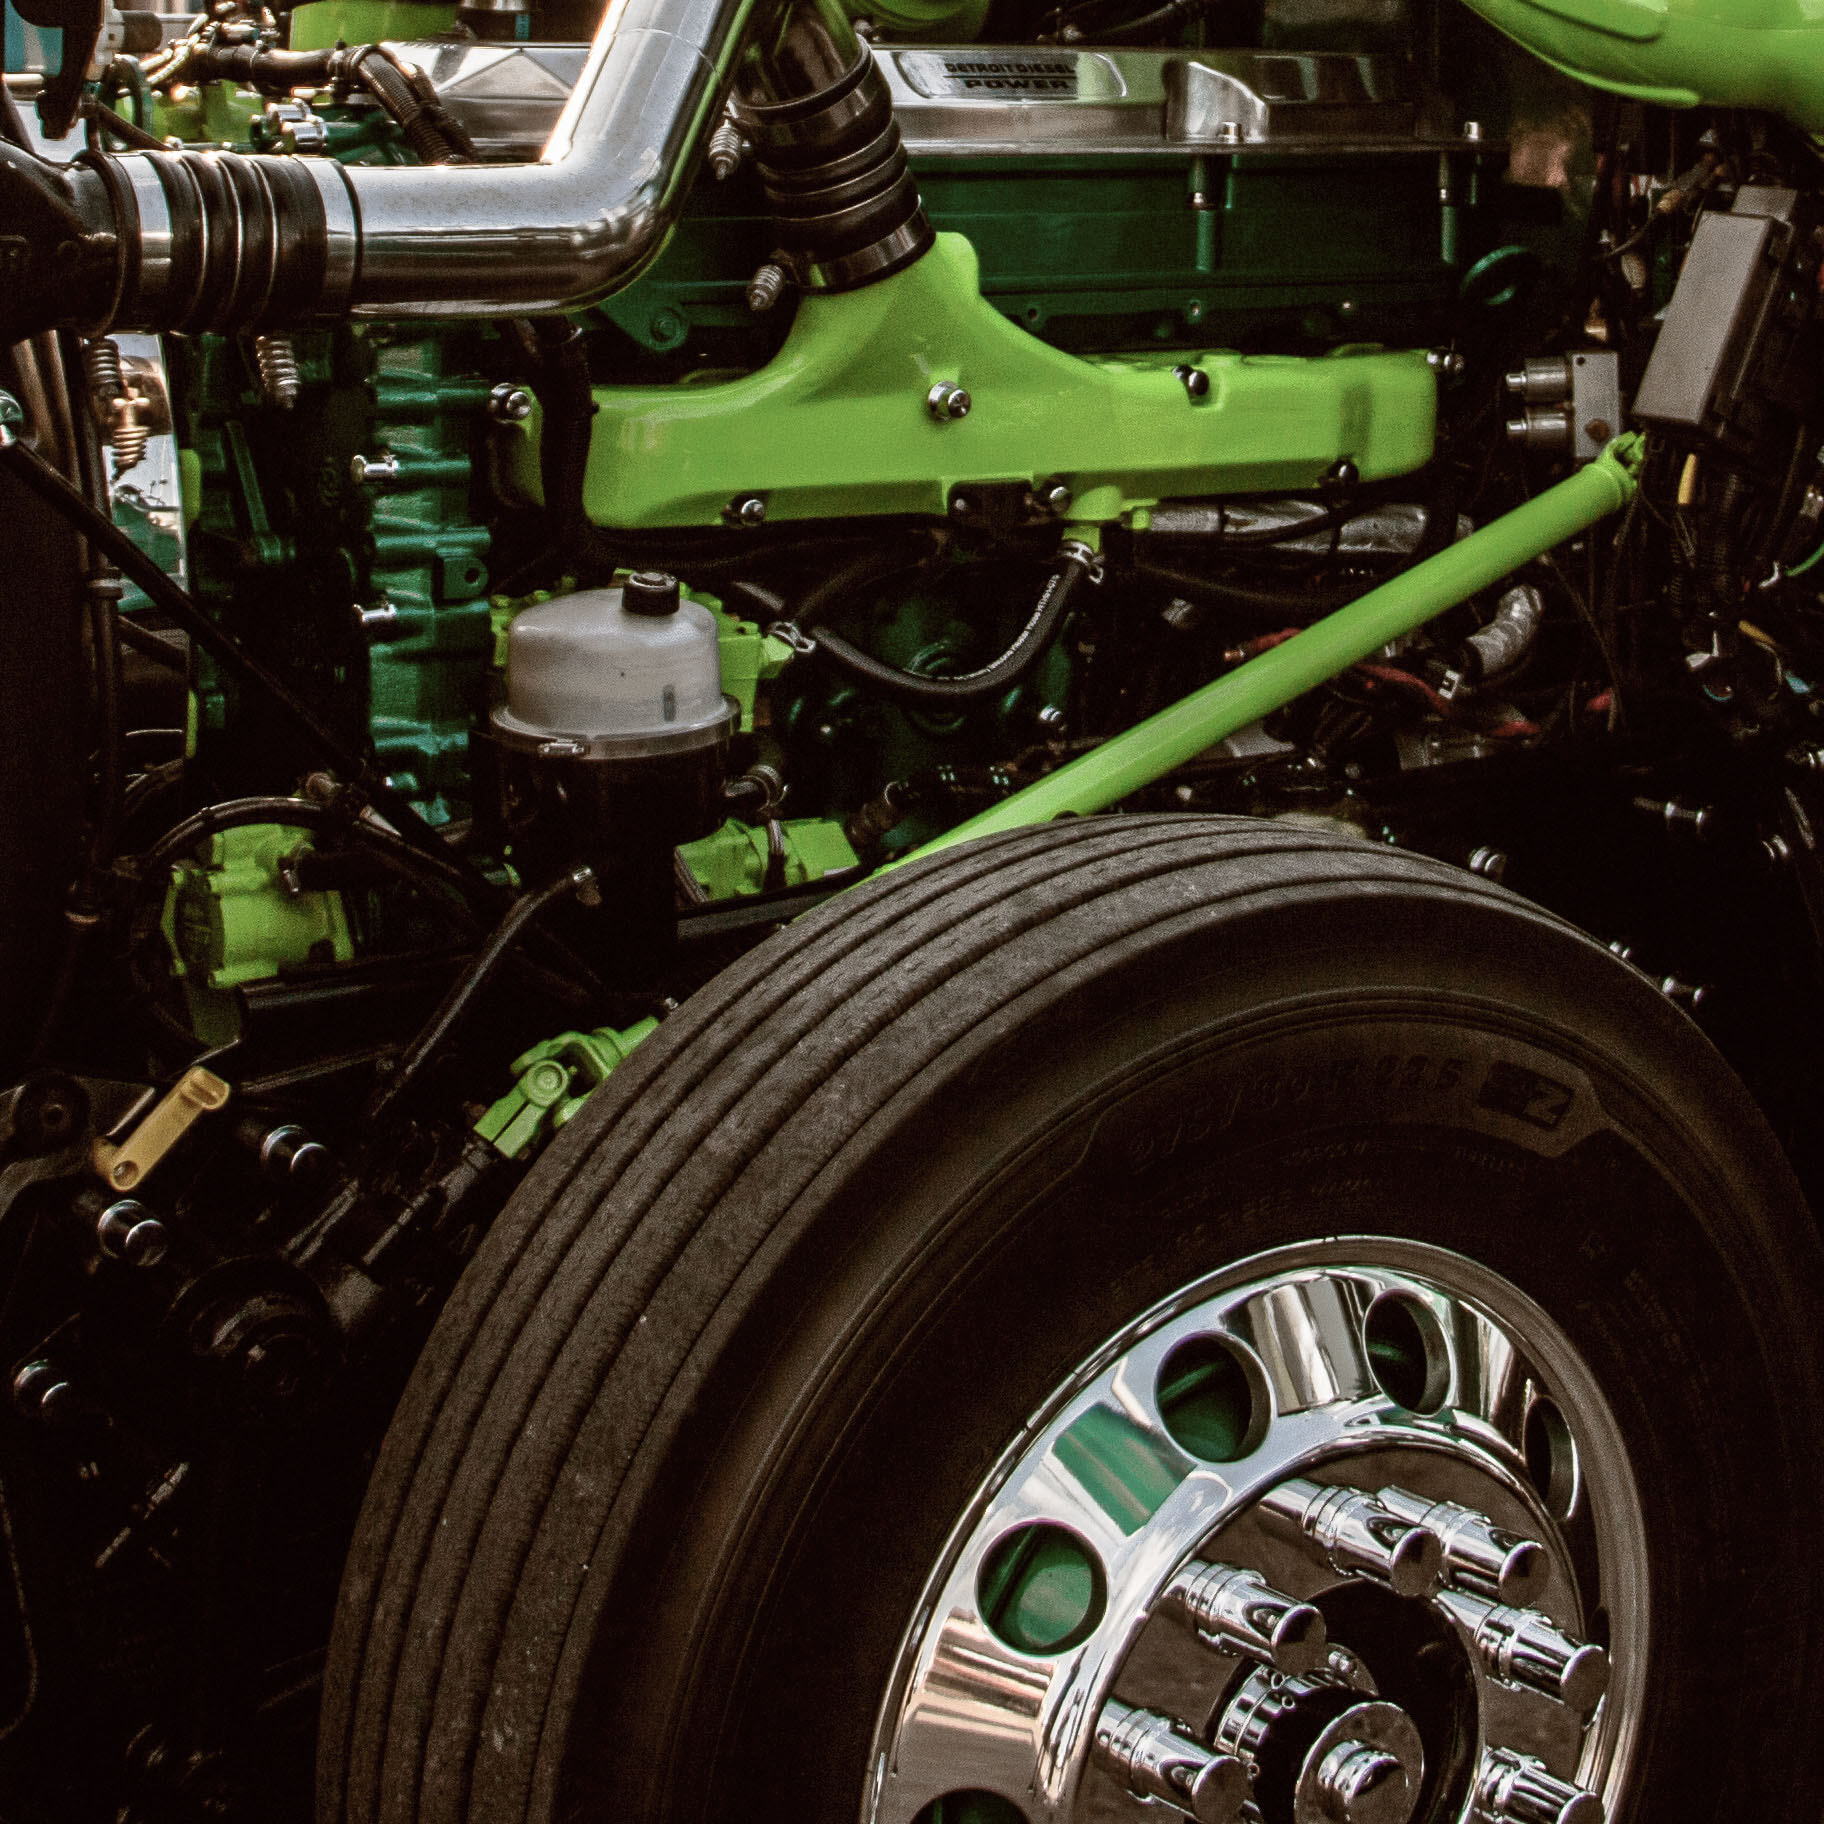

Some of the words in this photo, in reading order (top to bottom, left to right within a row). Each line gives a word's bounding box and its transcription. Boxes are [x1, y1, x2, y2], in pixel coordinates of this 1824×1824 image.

[944, 63, 1015, 73] DETROIT
[1016, 63, 1076, 74] DIESEL
[963, 79, 1070, 89] POWER
